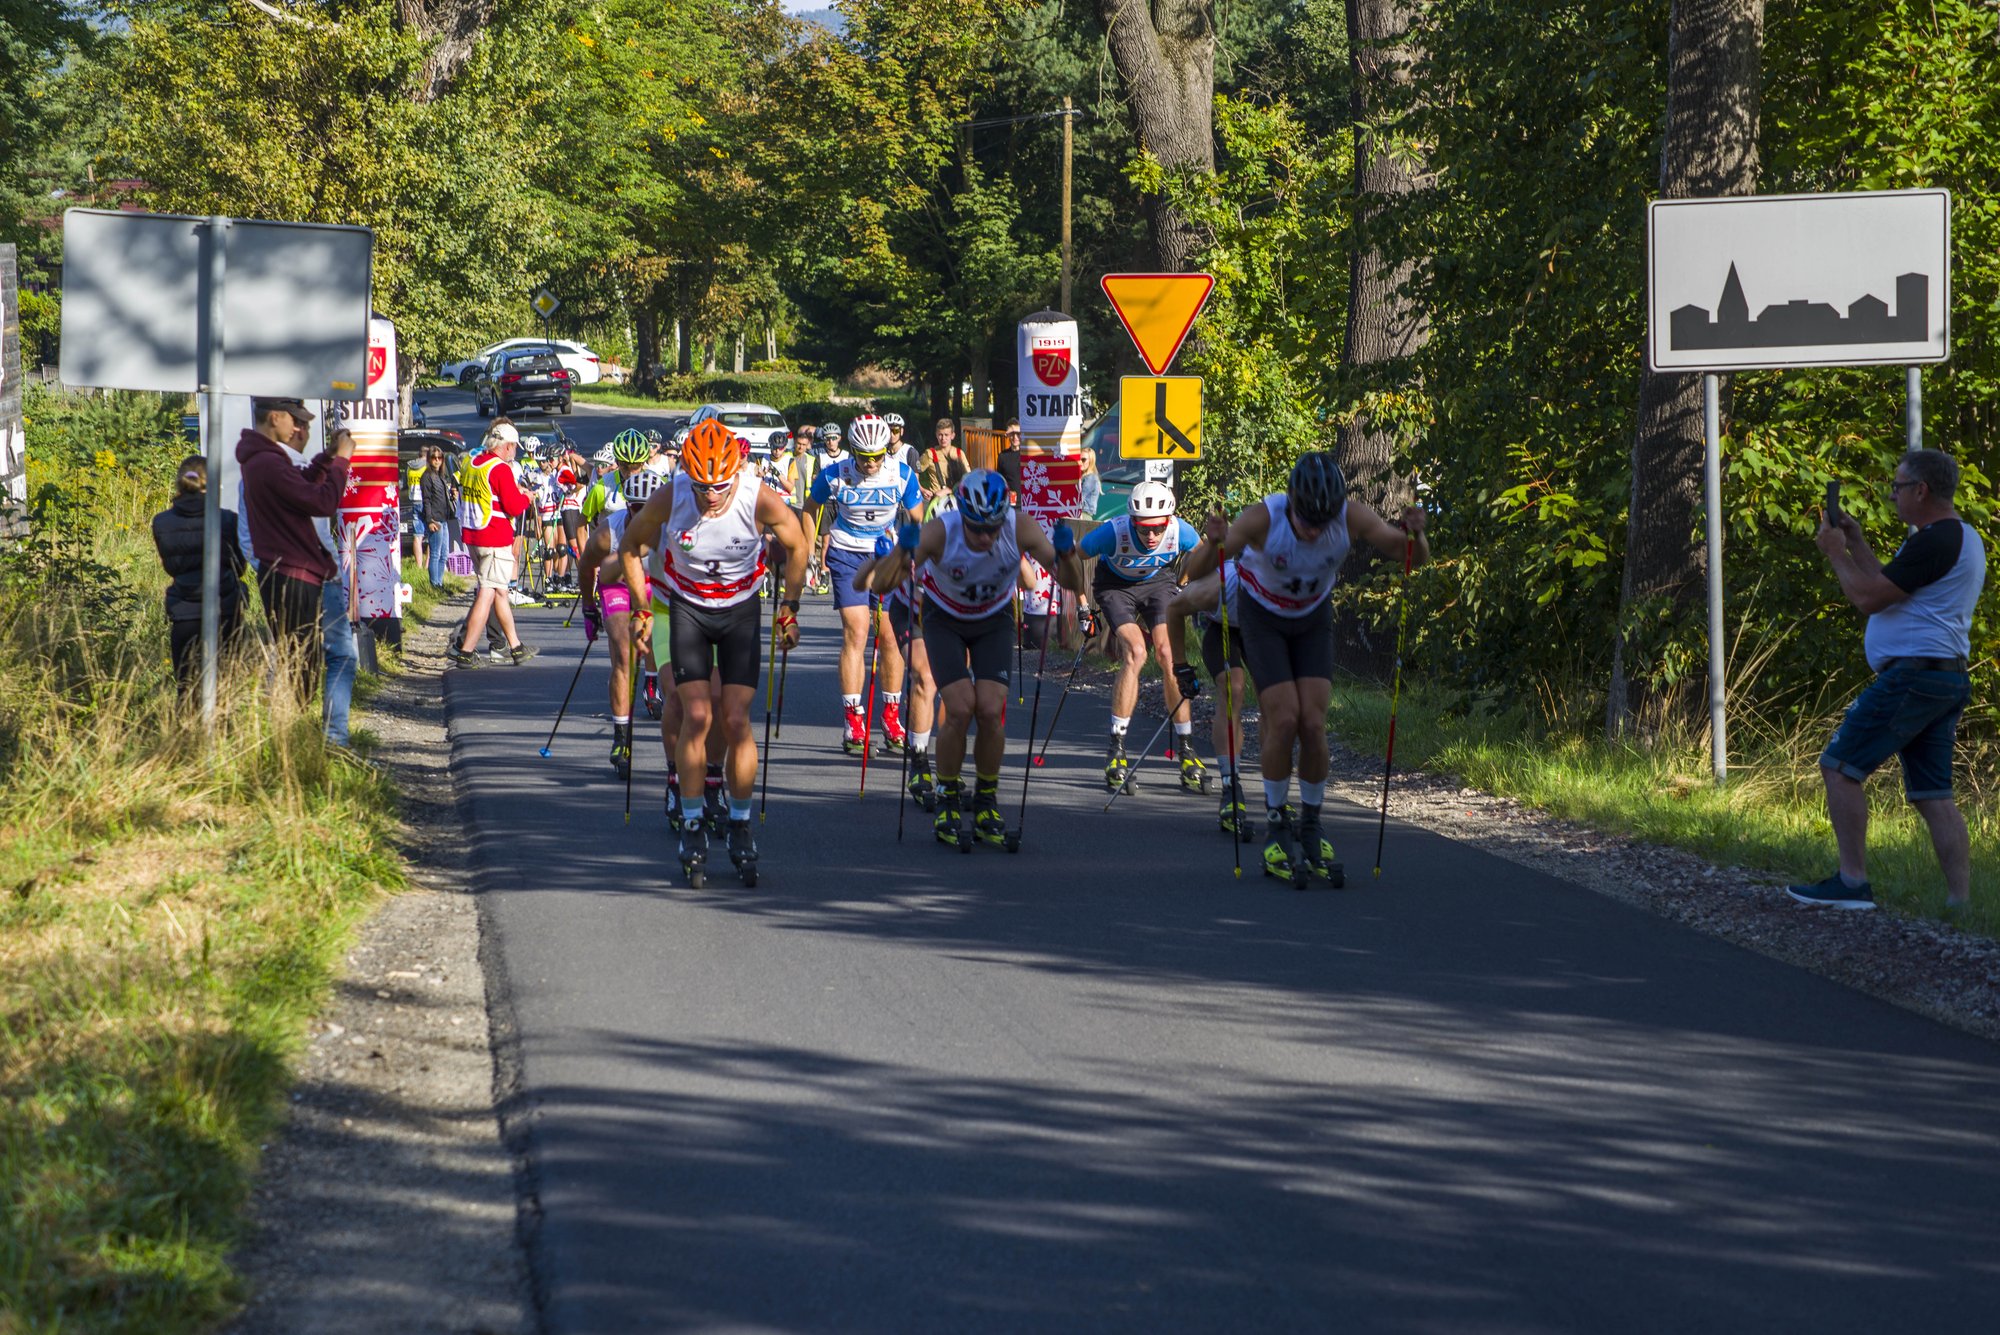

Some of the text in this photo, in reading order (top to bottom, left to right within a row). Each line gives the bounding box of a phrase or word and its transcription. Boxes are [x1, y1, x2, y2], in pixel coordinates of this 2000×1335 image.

[1039, 353, 1067, 377] PZN
[340, 398, 395, 420] START
[1026, 394, 1079, 417] START
[843, 488, 897, 504] DZN
[865, 511, 875, 521] 5
[1115, 554, 1174, 567] DZN
